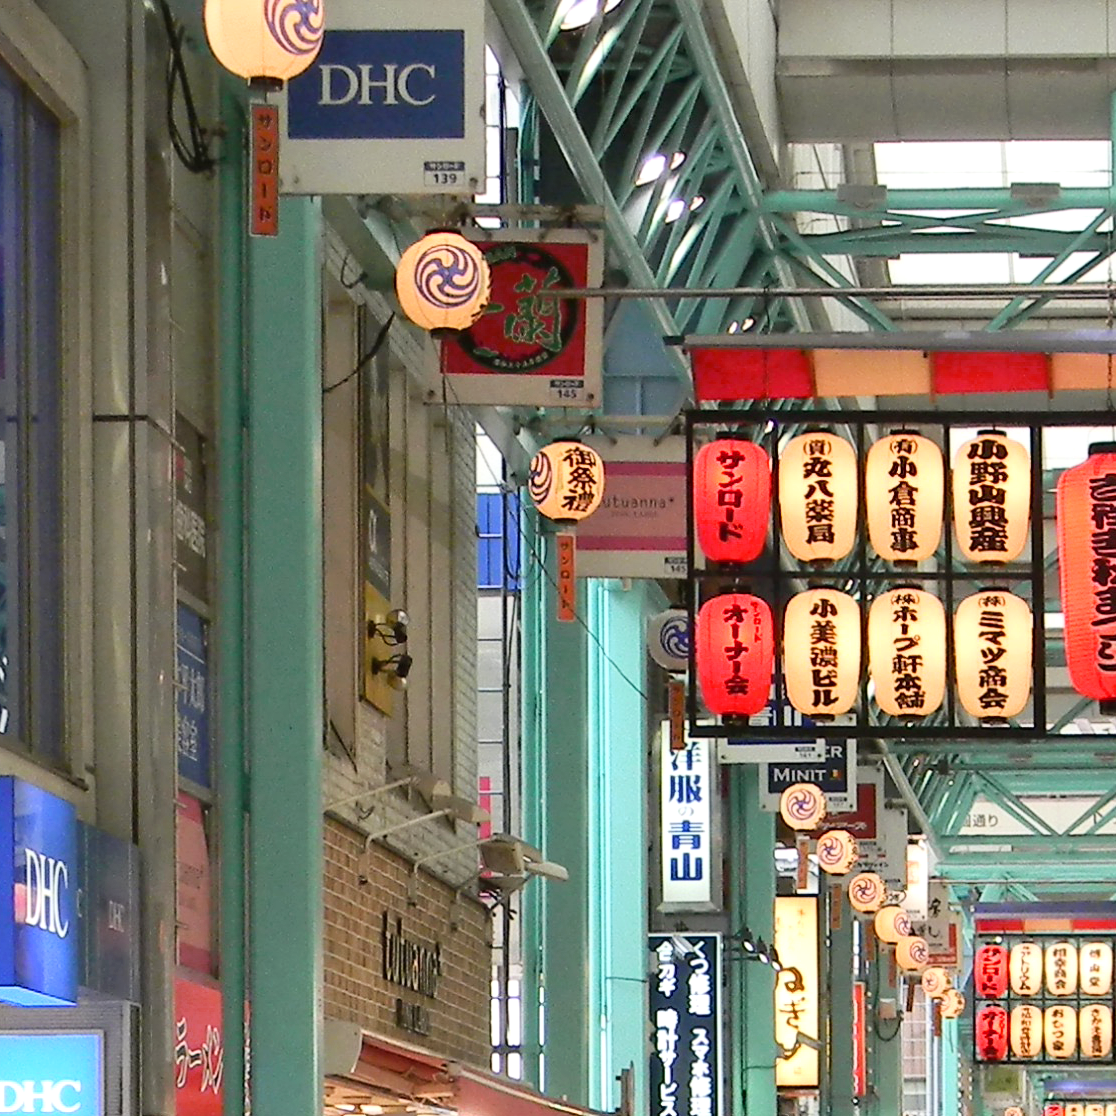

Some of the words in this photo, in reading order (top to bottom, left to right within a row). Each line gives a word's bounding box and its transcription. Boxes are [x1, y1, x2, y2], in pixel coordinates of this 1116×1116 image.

[317, 63, 436, 106] DHC
[433, 173, 457, 184] 139
[557, 389, 577, 399] 145
[560, 446, 597, 513] 御祭禮
[716, 450, 746, 543] サンロード
[967, 439, 1009, 552] 小野山興産
[723, 603, 749, 696] オーナー会
[810, 598, 839, 708] 小美濃ビル
[668, 741, 705, 882] 洋服の青山
[773, 767, 826, 782] MINIT
[24, 848, 69, 939] DHC
[0, 1079, 82, 1114] DHC
